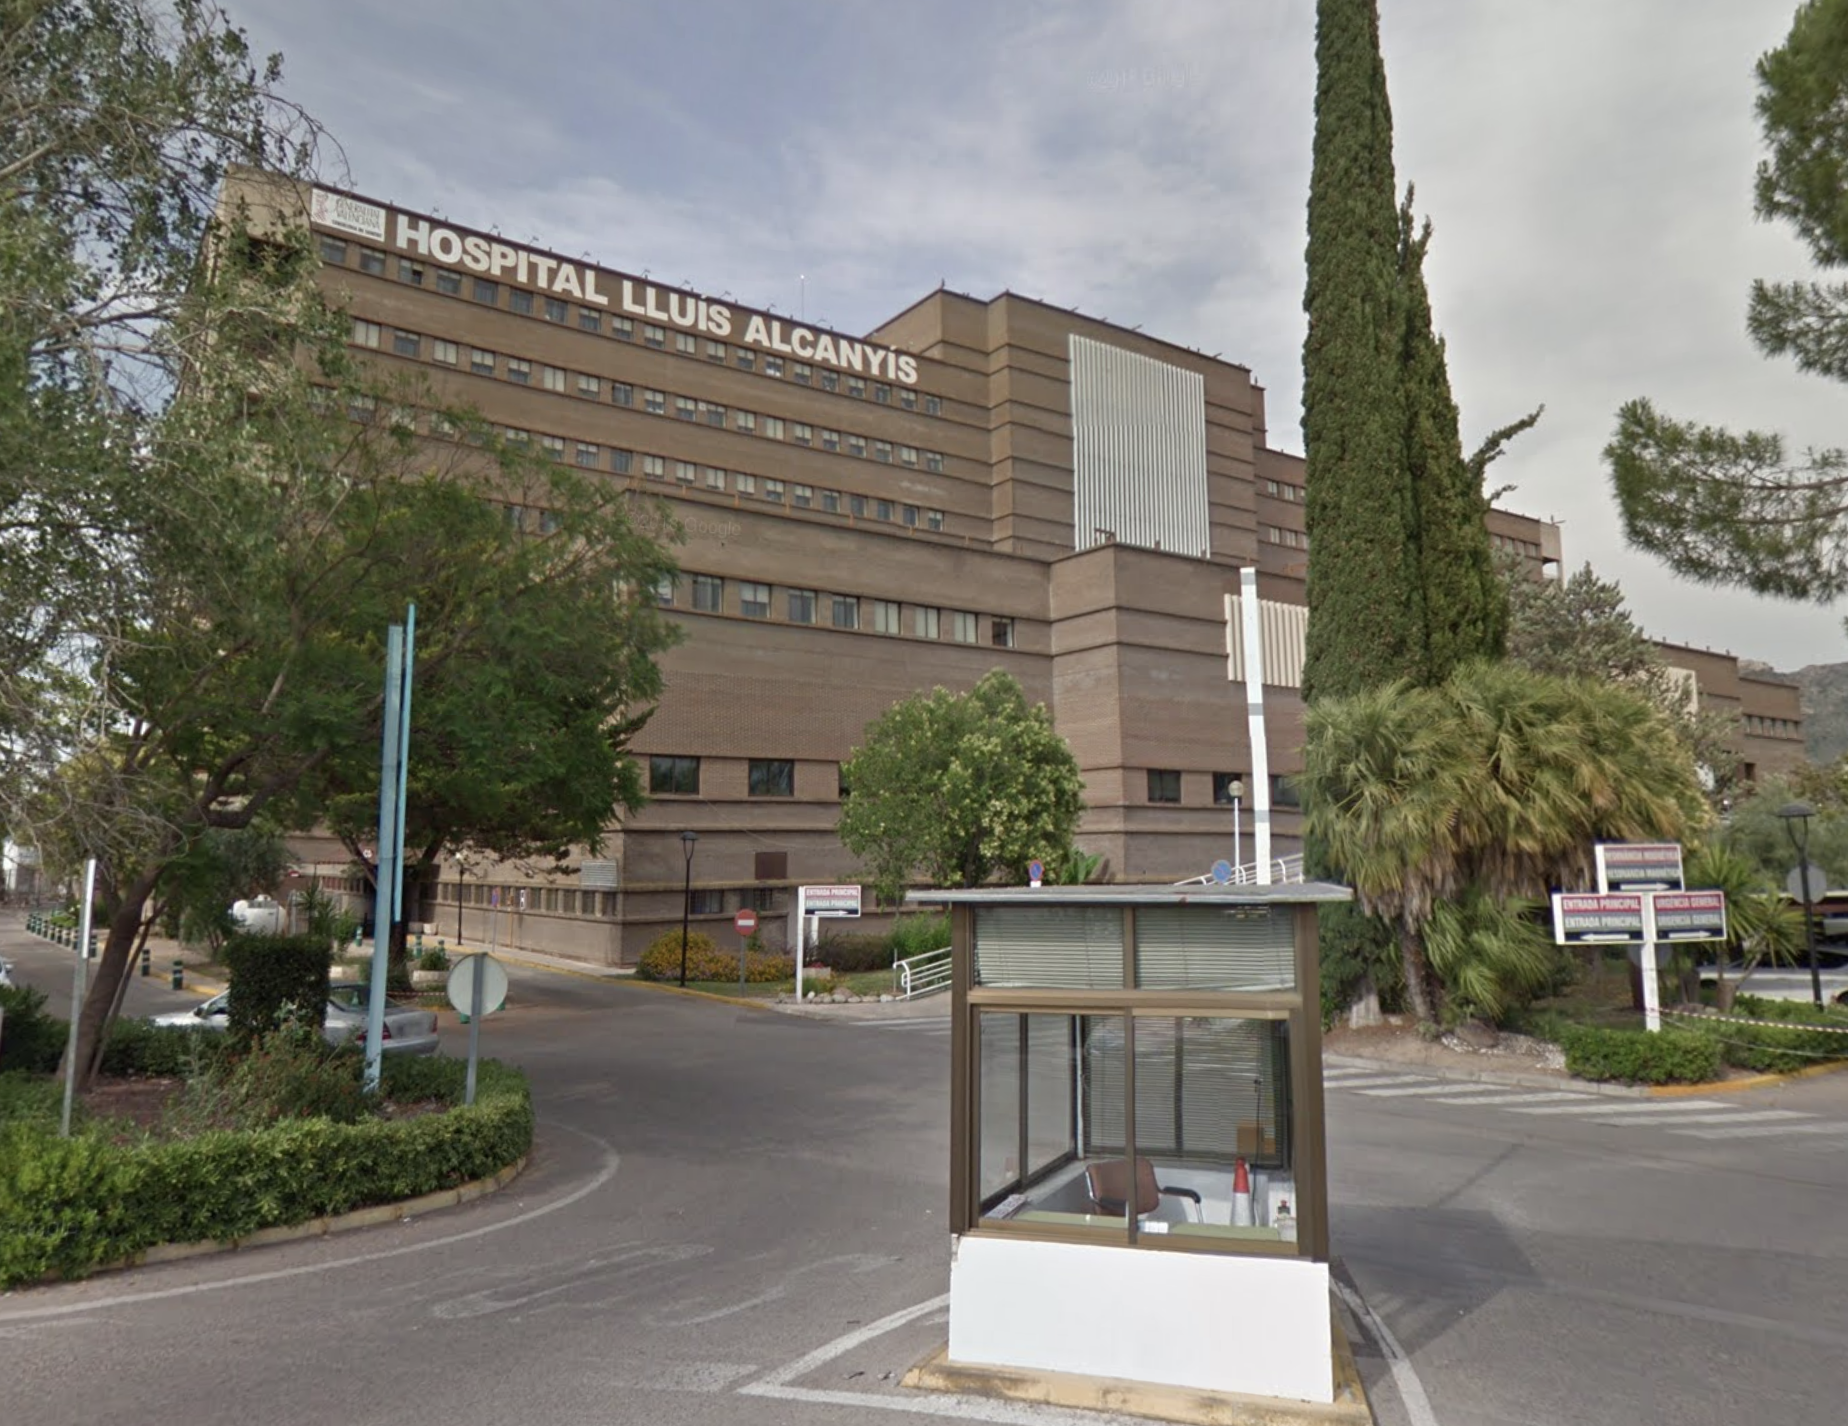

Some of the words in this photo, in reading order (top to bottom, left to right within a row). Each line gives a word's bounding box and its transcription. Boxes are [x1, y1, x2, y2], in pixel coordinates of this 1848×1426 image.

[396, 213, 608, 306] HOSPITAL
[622, 279, 731, 337] LLUÍS
[744, 314, 919, 386] ALCANYÍS
[806, 888, 830, 896] ENTRADA
[831, 888, 858, 896] PRINCIPAL
[806, 899, 830, 907] ENTRADA
[831, 899, 858, 907] PRINCIPAL
[1563, 898, 1598, 910] ENTRADA
[1600, 897, 1640, 909] PRINCIPAL
[1691, 896, 1720, 907] GENERAL
[1564, 917, 1600, 928] ENTRADA
[1601, 916, 1641, 928] PRINCIPAL
[1692, 914, 1721, 925] GENERAL
